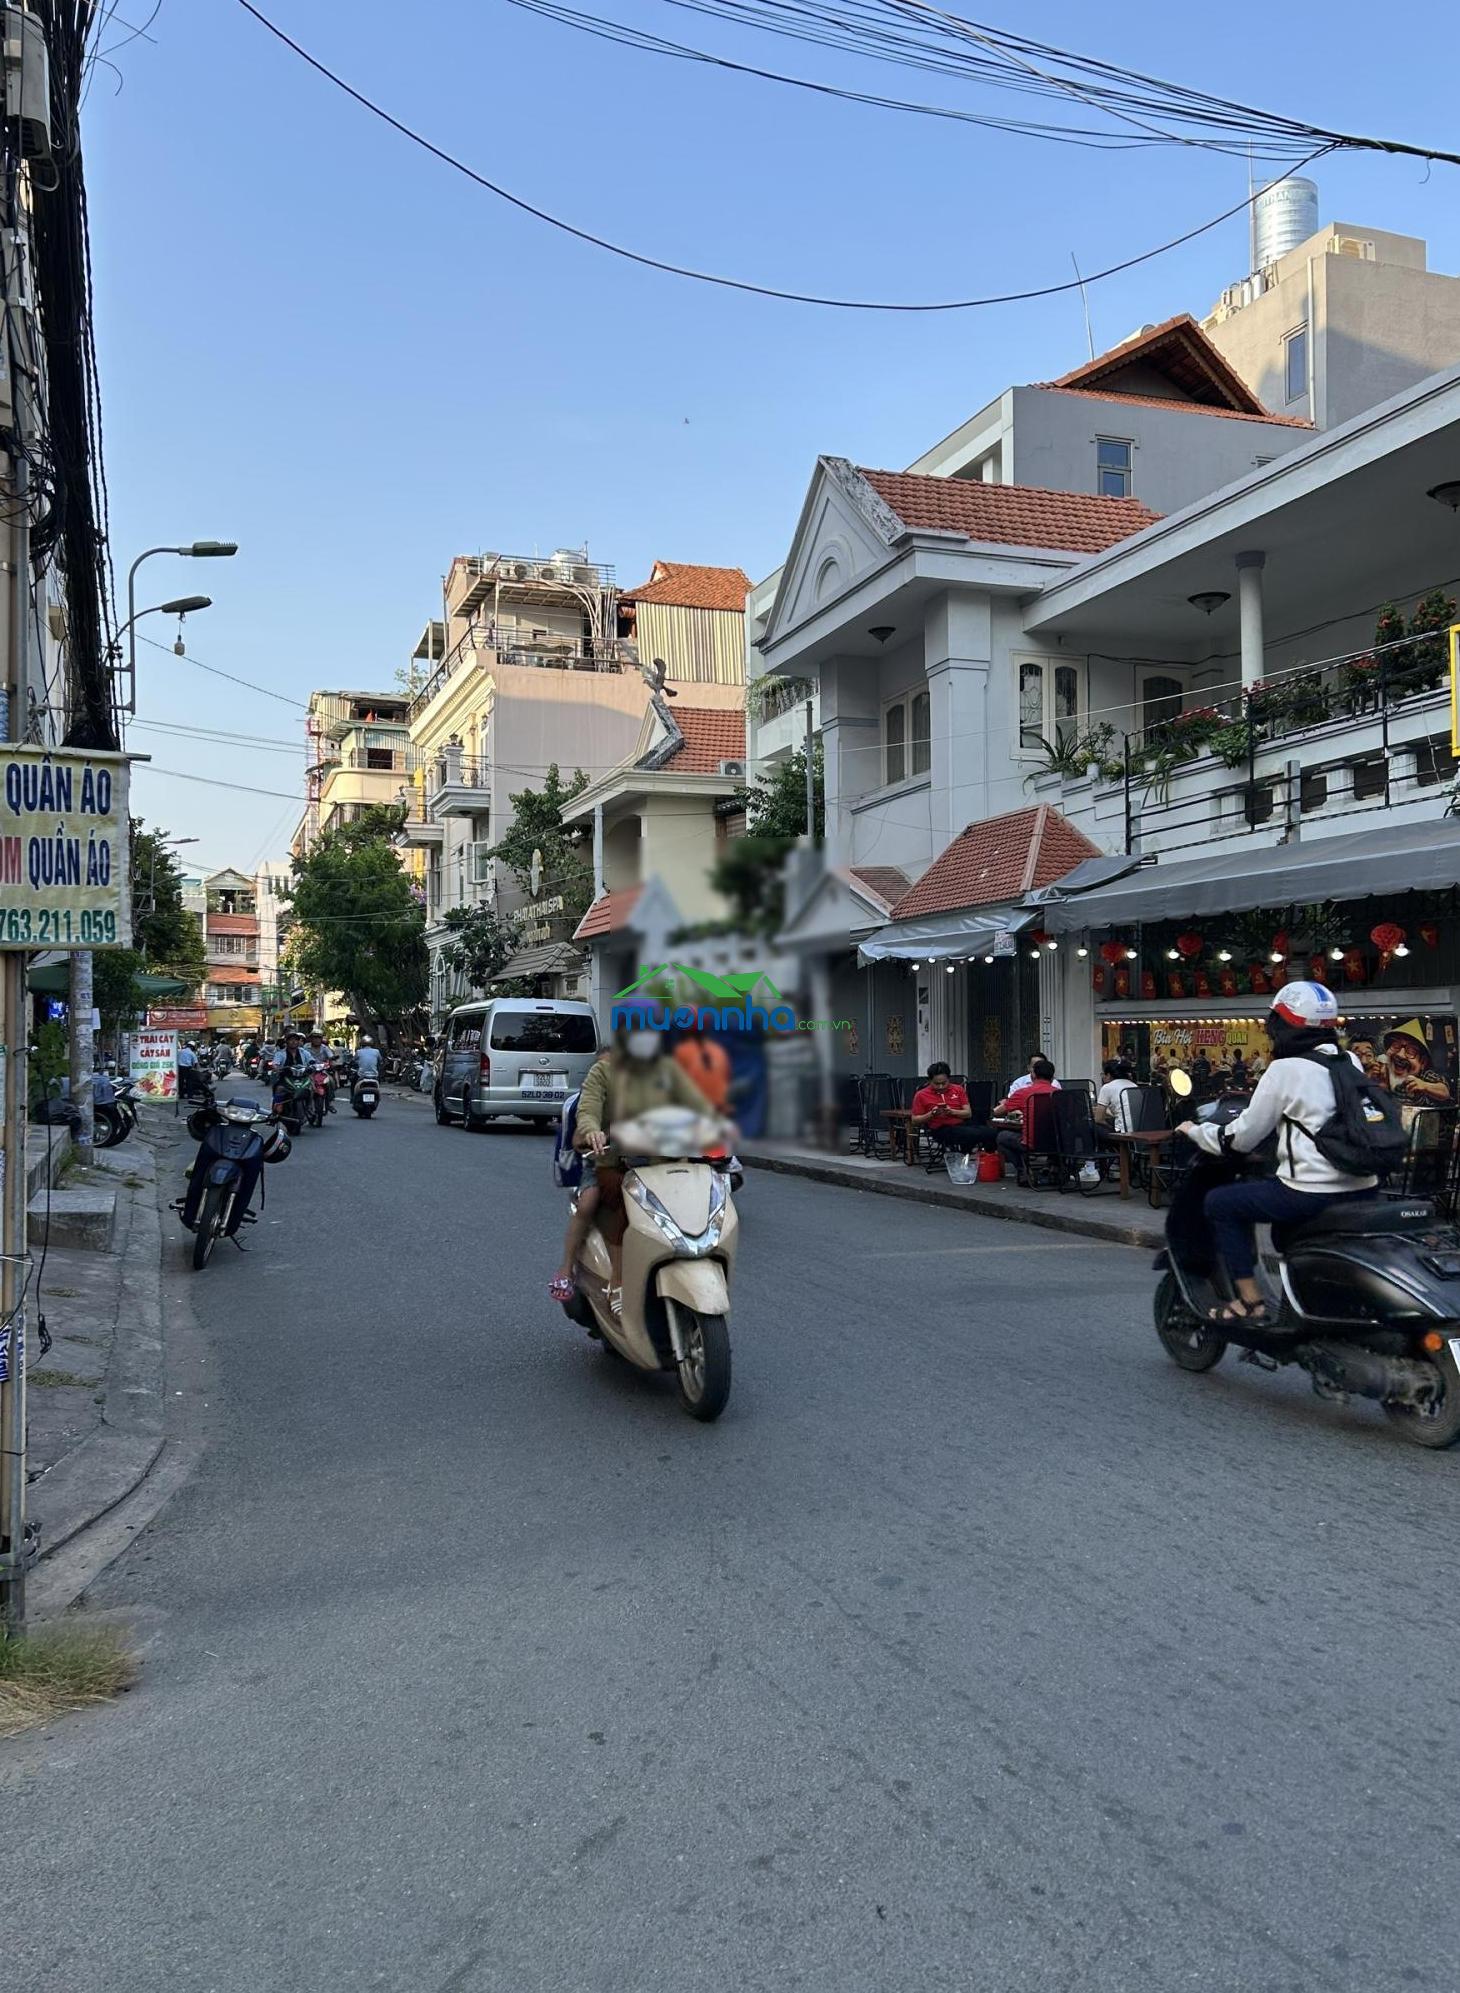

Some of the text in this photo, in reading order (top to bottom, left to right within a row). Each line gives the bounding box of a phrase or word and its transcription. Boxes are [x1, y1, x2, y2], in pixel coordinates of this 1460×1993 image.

[80, 760, 111, 816] ÁO
[28, 820, 80, 891] QUẦN
[86, 829, 110, 887] ÁO
